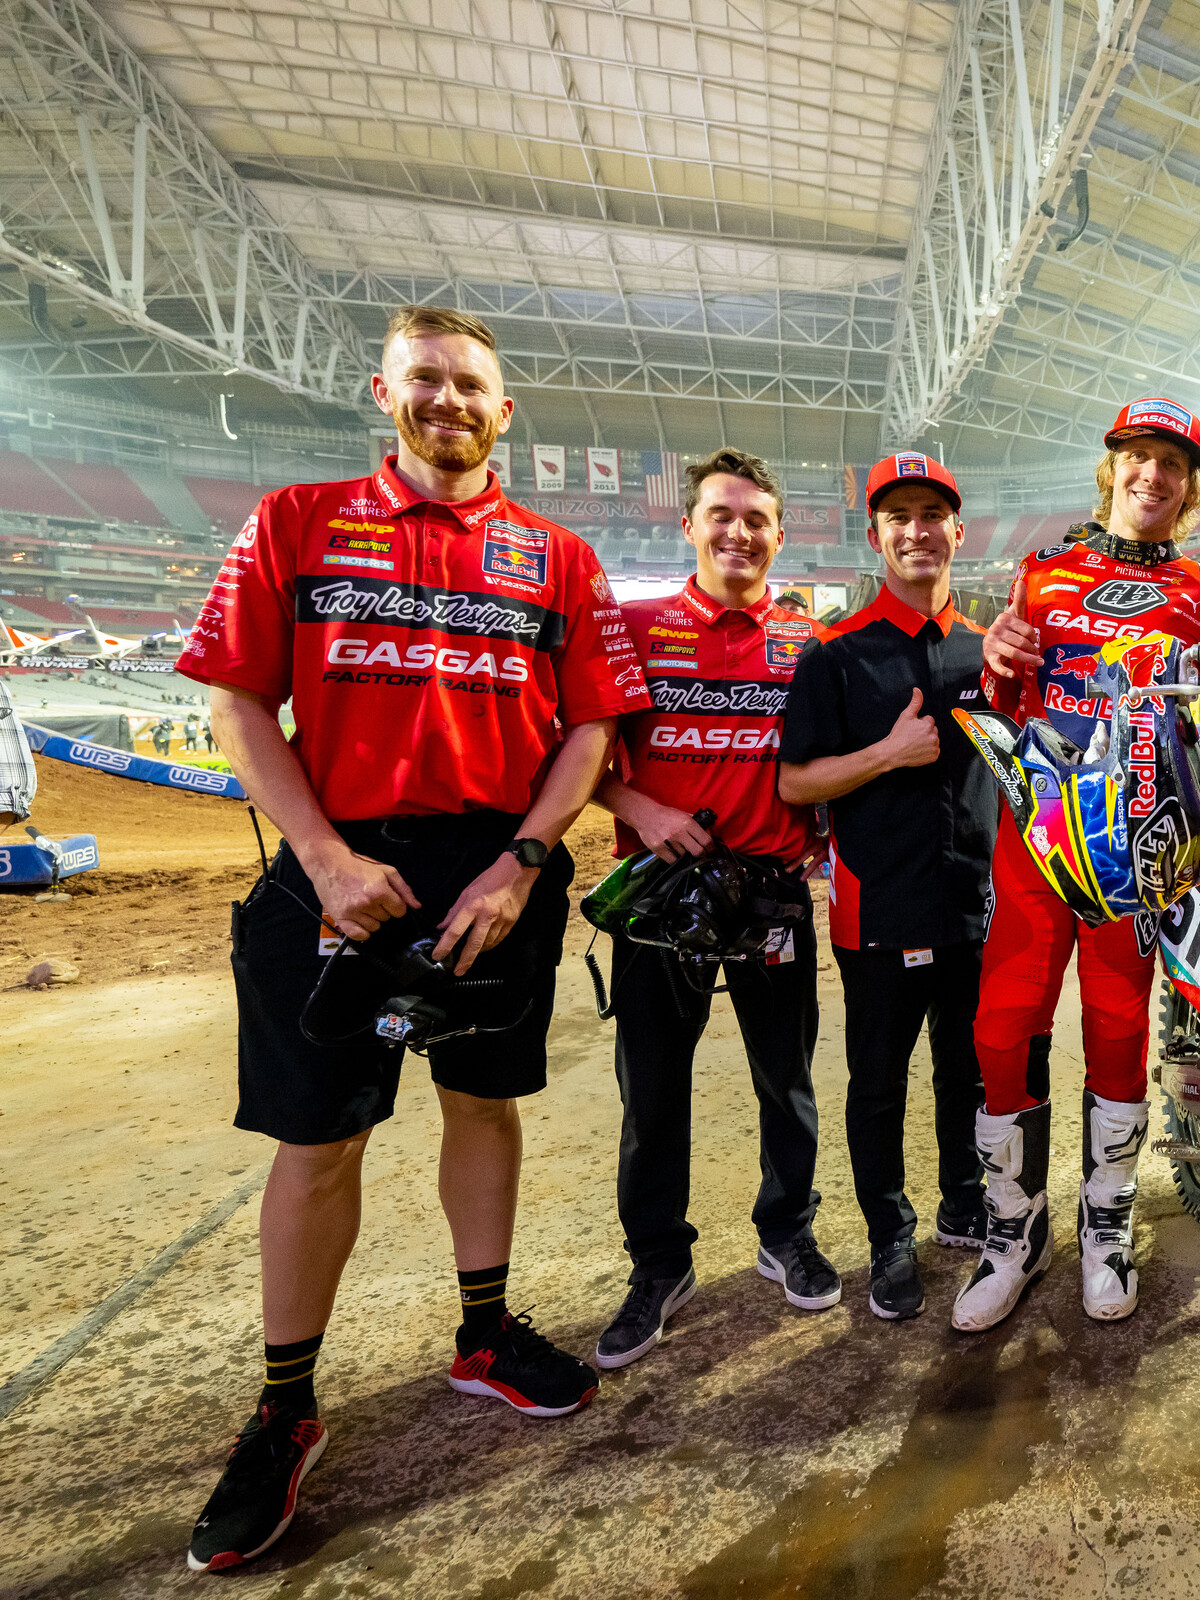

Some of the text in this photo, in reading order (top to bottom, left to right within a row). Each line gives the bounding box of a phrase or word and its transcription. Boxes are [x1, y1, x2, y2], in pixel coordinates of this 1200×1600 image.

[1131, 415, 1185, 433] GASGAS
[378, 474, 402, 509] ASGAS
[351, 498, 378, 507] SONY
[518, 498, 649, 518] ARIZONA
[339, 507, 388, 517] PICTURES
[490, 530, 545, 548] GASGAS
[340, 556, 391, 569] MOTOREX
[491, 560, 539, 580] Red Bull
[1079, 562, 1106, 570] GASGAS
[1115, 566, 1152, 579] PICTURES
[500, 579, 542, 595] seaspan
[310, 580, 541, 634] Troy Lee Designs
[592, 608, 622, 618] METH
[663, 609, 686, 618] SONY
[655, 616, 693, 626] PICTURES
[1045, 609, 1162, 642] GASG
[192, 626, 219, 640] ENA
[604, 637, 631, 646] GoPr
[769, 629, 810, 637] GASGAS
[327, 638, 529, 682] GASGAS
[658, 659, 696, 668] MOTOREX
[772, 654, 789, 663] Red
[322, 671, 522, 698] FACTORY RACING
[649, 680, 789, 715] Troy Lee Desig
[1043, 683, 1090, 713] Red
[650, 726, 781, 749] GASGA
[70, 744, 132, 771] WPS
[647, 752, 779, 764] FACTORY RACI
[1128, 712, 1156, 819] Red Bull
[169, 766, 228, 792] WPS
[207, 765, 232, 775] Ka
[1117, 794, 1125, 829] seaspan
[62, 846, 96, 870] WPS
